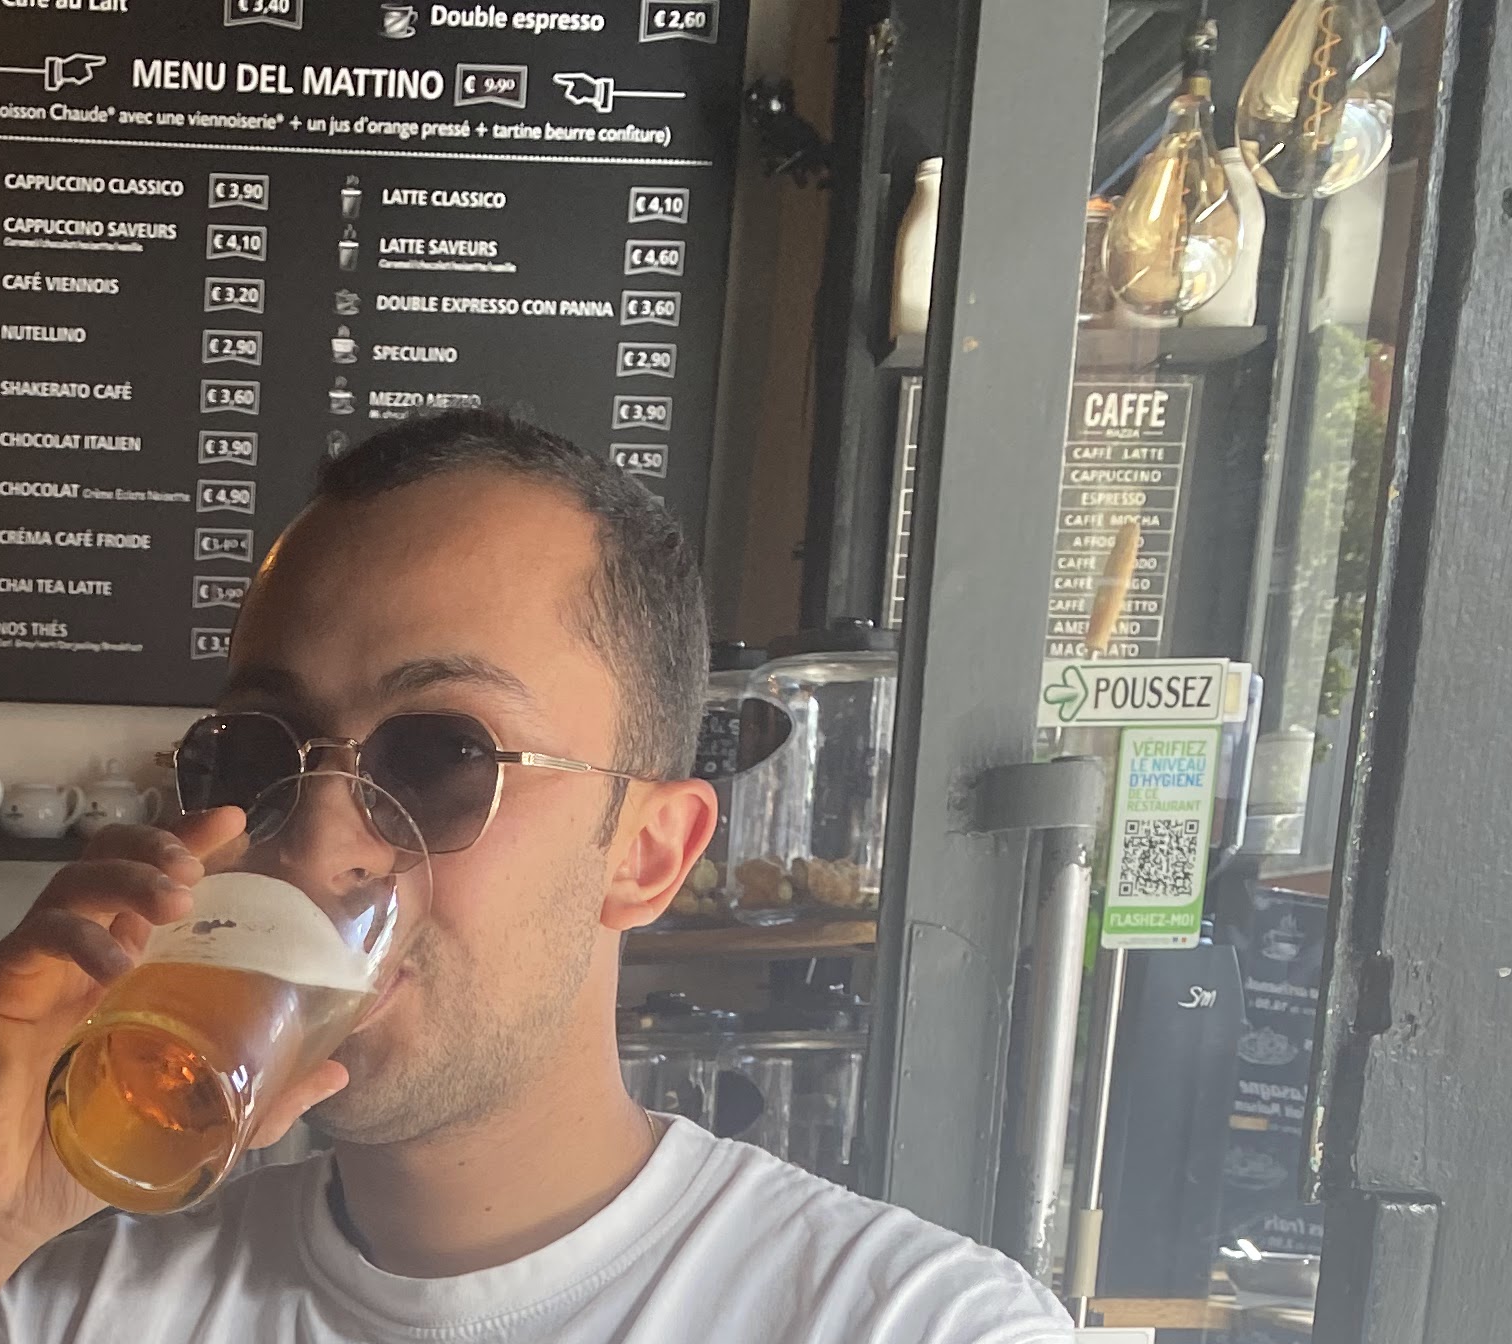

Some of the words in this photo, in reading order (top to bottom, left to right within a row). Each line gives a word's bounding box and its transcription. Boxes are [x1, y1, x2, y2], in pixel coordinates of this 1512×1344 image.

[431, 5, 506, 28] Double
[512, 9, 605, 34] espresso
[668, 11, 706, 30] 2,60
[132, 58, 226, 91] MENU
[236, 62, 293, 94] DEL
[301, 66, 444, 99] MATTINO
[119, 110, 153, 124] avec
[156, 111, 185, 126] une
[307, 119, 327, 133] un
[329, 117, 351, 136] jus
[354, 115, 418, 139] d'orange
[422, 119, 470, 138] pressé
[492, 123, 542, 141] tartine
[544, 125, 595, 142] beurre
[598, 126, 672, 147] confiture)
[4, 173, 105, 193] CAPPUCCINO
[108, 176, 185, 197] CLASSICO
[228, 183, 264, 200] 3,90
[382, 189, 427, 206] LATTE
[431, 190, 506, 209] CLASSICO
[3, 217, 104, 237] CAPPUCCINO
[107, 221, 178, 240] SAVEURS
[379, 238, 425, 255] LATTE
[428, 239, 498, 258] SAVEURS
[2, 271, 42, 291] CAFÉ
[45, 277, 120, 295] VIENNOIS
[376, 295, 438, 313] DOUBLE
[441, 297, 519, 316] EXPRESSO
[522, 299, 557, 317] CON
[559, 300, 615, 318] PANNA
[1, 324, 86, 343] NUTELLINO
[373, 344, 458, 363] SPECULINO
[0, 380, 90, 399] SHAKERATO
[93, 381, 133, 400] CAFÉ
[0, 432, 81, 449] CHOCOLAT
[84, 435, 141, 451] ITALIEN
[1122, 447, 1165, 461] LATTE
[1070, 469, 1162, 483] CAPPUCCINO
[1081, 491, 1147, 507] ESPRESSO
[55, 528, 93, 548] CAFÉ
[96, 533, 152, 550] FROIDE
[36, 578, 65, 595] TEA
[68, 580, 113, 597] LATTE
[31, 619, 68, 638] THÉS
[1093, 676, 1214, 710] POUSSEZ
[1133, 737, 1208, 757] VÉRIFIEZ
[1131, 758, 1150, 772] LE
[1152, 758, 1206, 772] NIVEAU
[1128, 788, 1142, 800] DE
[1145, 787, 1159, 800] CE
[1127, 800, 1202, 812] RESTAURANT
[1109, 912, 1195, 927] FLASHEZ-MOI
